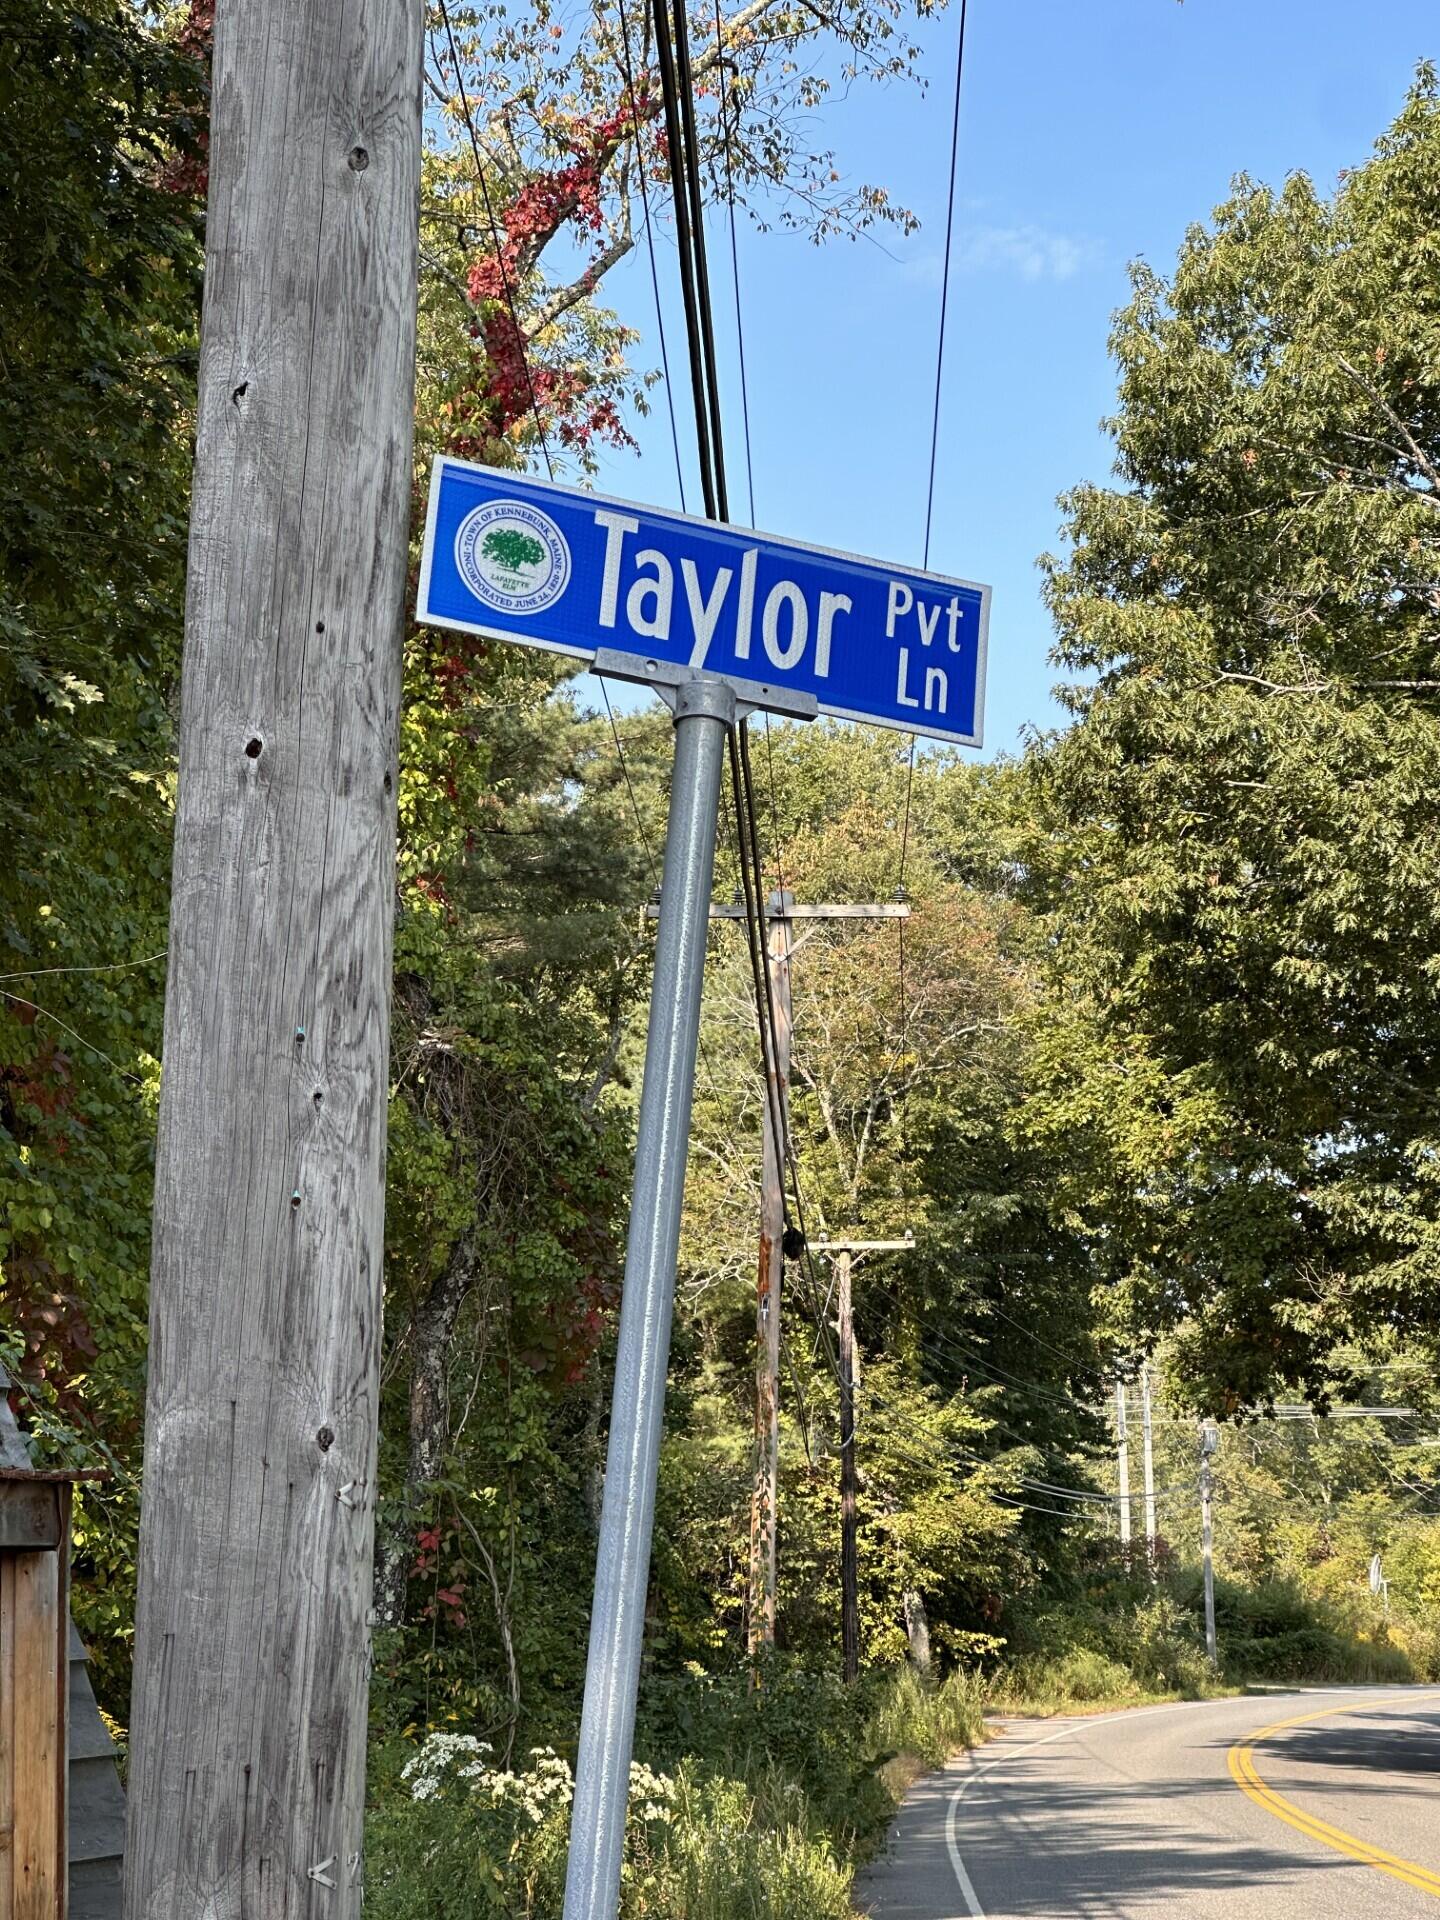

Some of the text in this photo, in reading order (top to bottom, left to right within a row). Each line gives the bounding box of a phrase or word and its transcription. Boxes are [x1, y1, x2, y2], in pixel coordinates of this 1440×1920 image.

[465, 520, 482, 547] TOWN
[480, 510, 493, 522] OF
[549, 538, 562, 571] MAINE
[464, 551, 512, 606] INCORPORATED
[514, 597, 538, 608] JUNE
[594, 509, 852, 678] Taylor
[886, 581, 964, 653] Pvt
[896, 647, 948, 713] Ln
